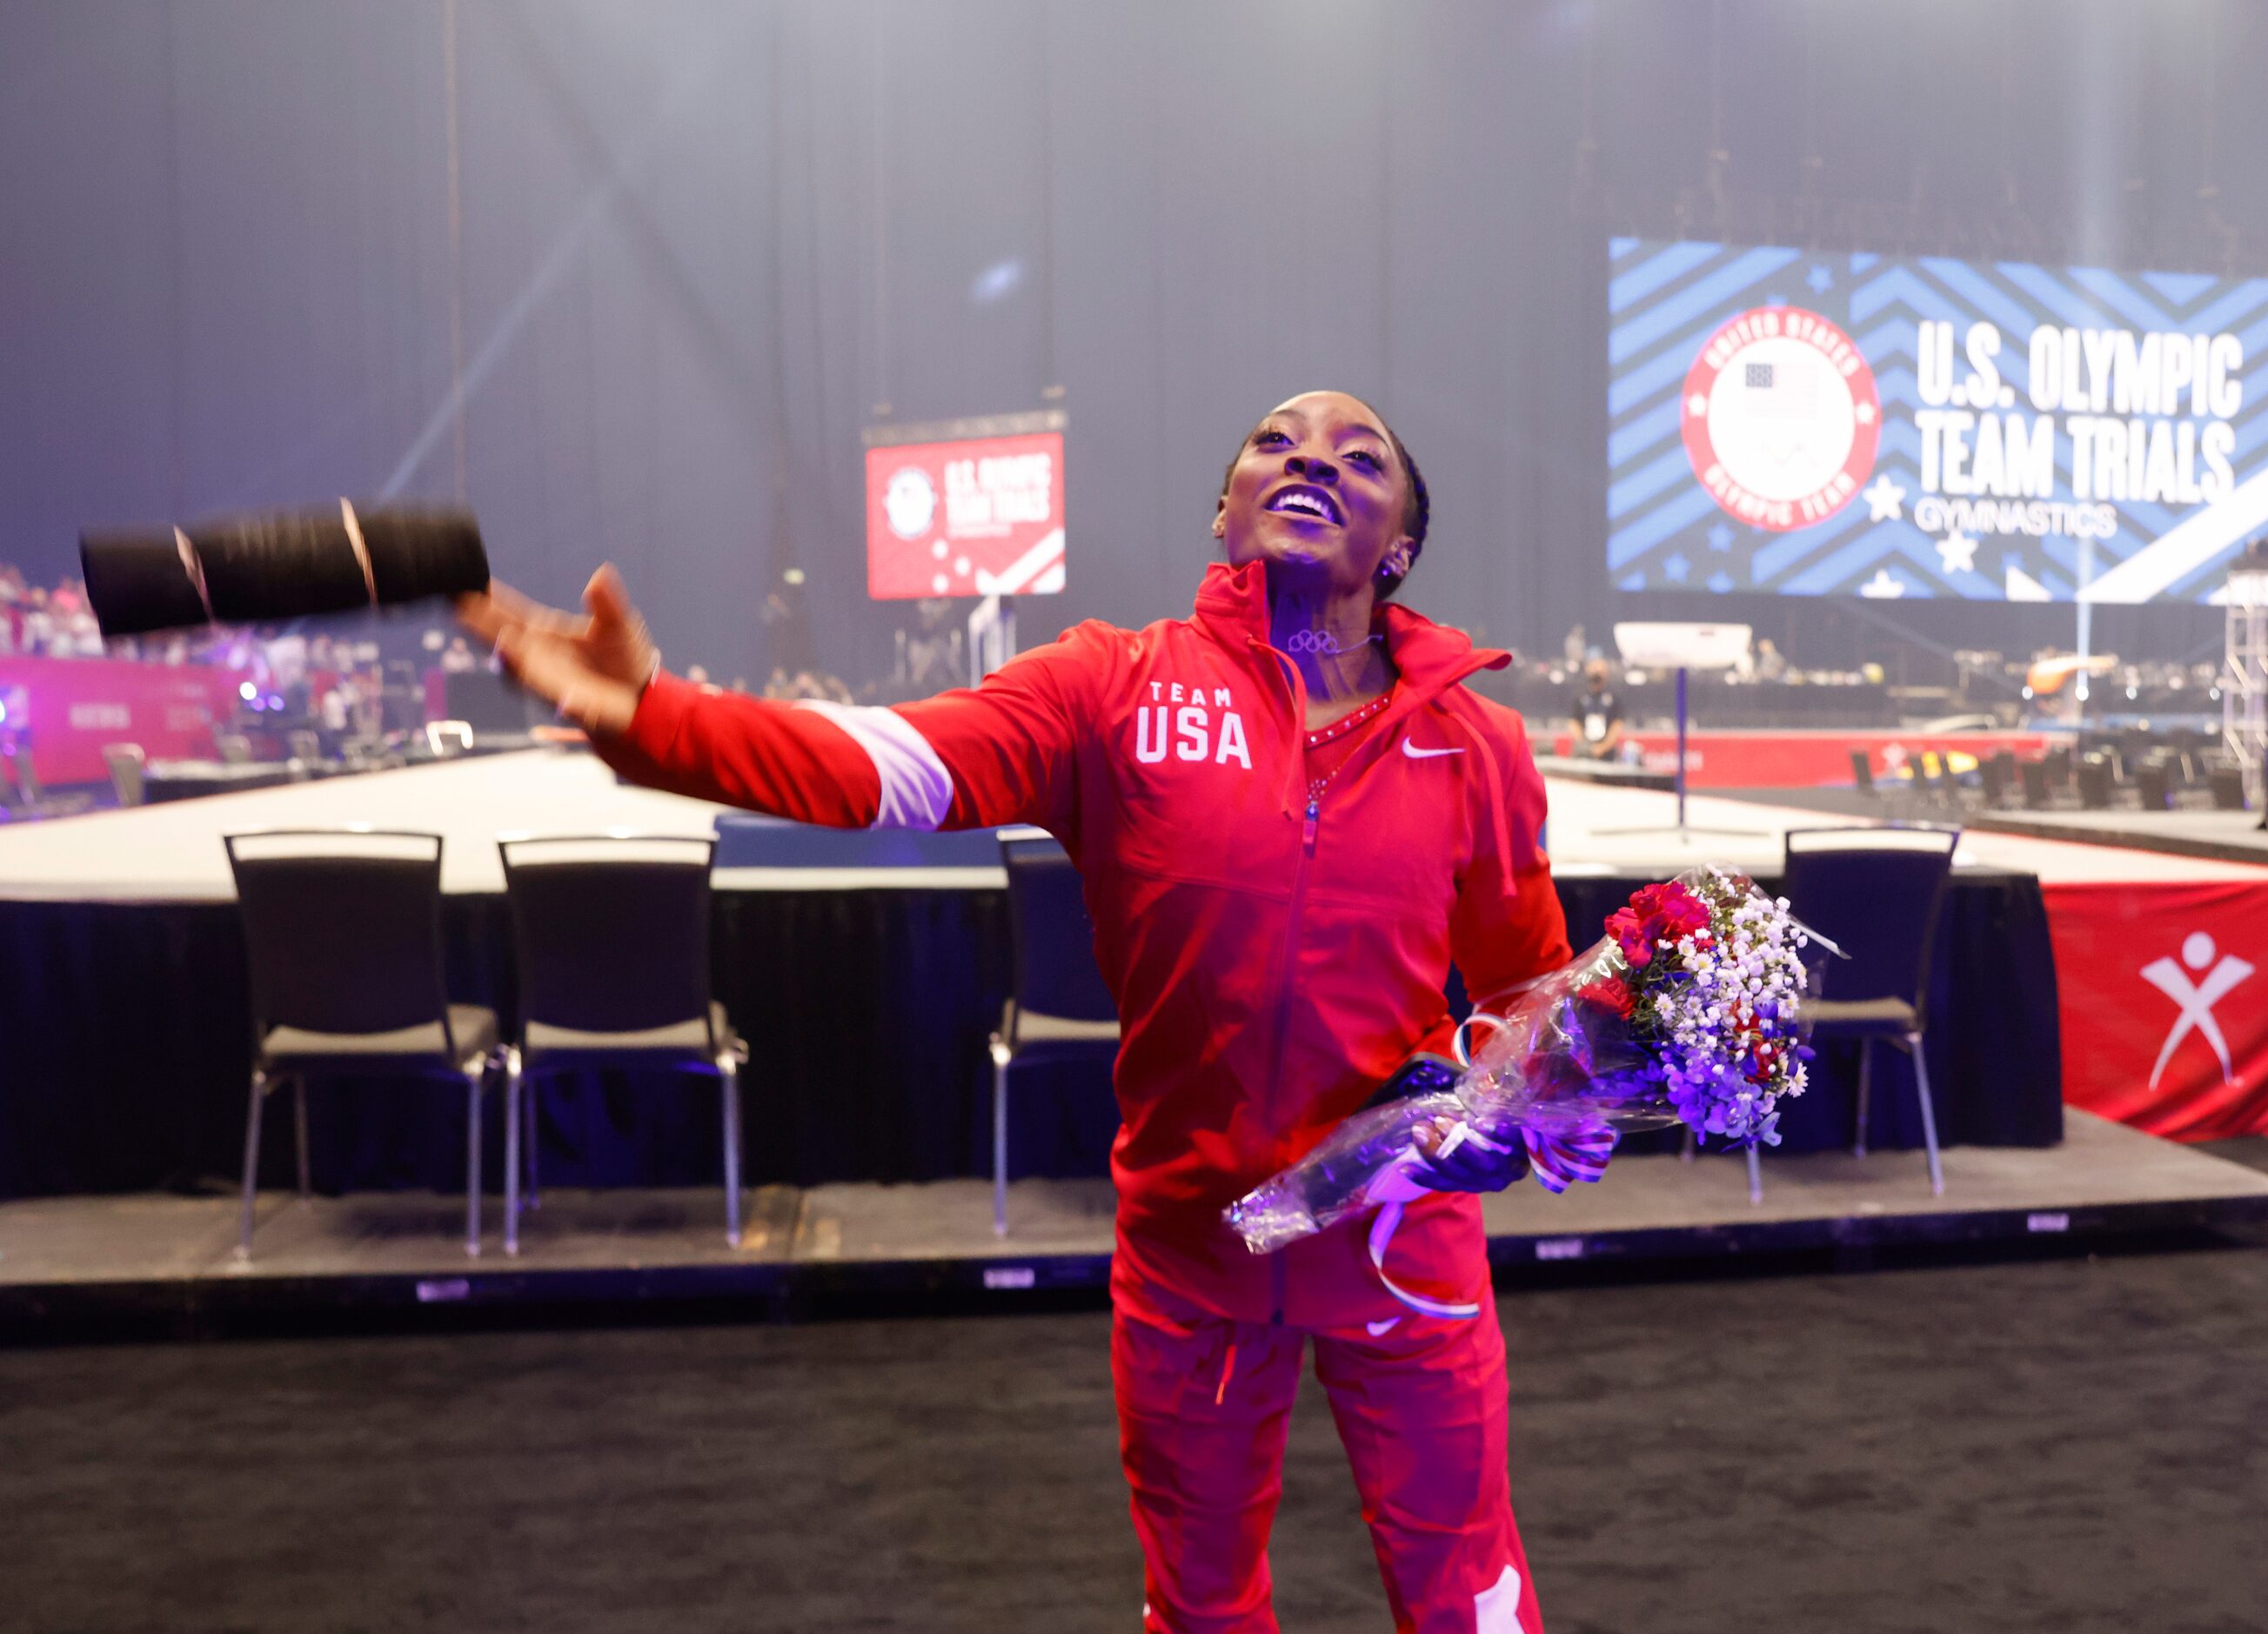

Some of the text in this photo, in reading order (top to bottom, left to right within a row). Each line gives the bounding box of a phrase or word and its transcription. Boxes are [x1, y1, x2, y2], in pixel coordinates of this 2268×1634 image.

[1917, 319, 2244, 419] U.S. OLYMPIC
[1915, 409, 2237, 505] TEAM TRIALS
[1914, 496, 2118, 539] GYMNASTICS
[1149, 680, 1232, 707] TEAM
[1136, 705, 1253, 769] USA
